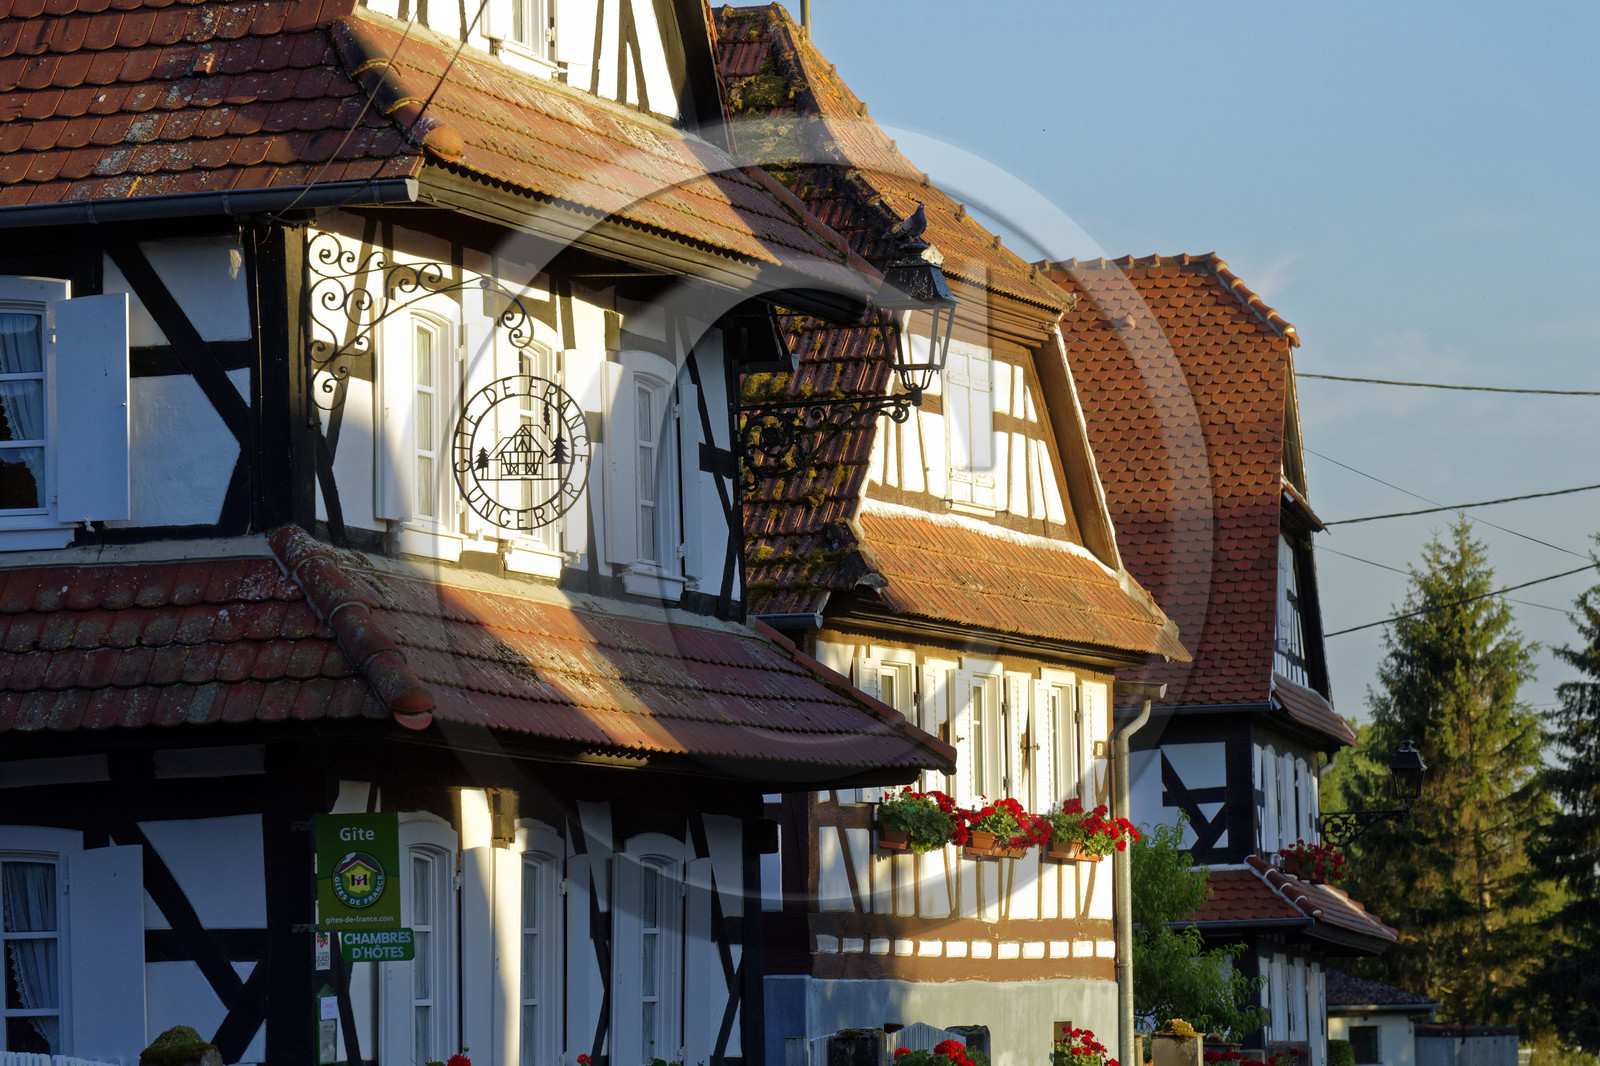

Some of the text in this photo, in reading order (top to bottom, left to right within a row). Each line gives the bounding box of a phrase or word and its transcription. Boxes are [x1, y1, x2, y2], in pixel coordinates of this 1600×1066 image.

[483, 377, 516, 406] DE
[528, 377, 590, 466] FRANCE
[467, 482, 581, 529] UNGERER
[339, 827, 375, 841] Gîte
[350, 898, 360, 906] DE
[363, 874, 384, 905] FRANCE
[325, 915, 394, 925] gites-de-france.com
[344, 931, 411, 945] CHAMBRES
